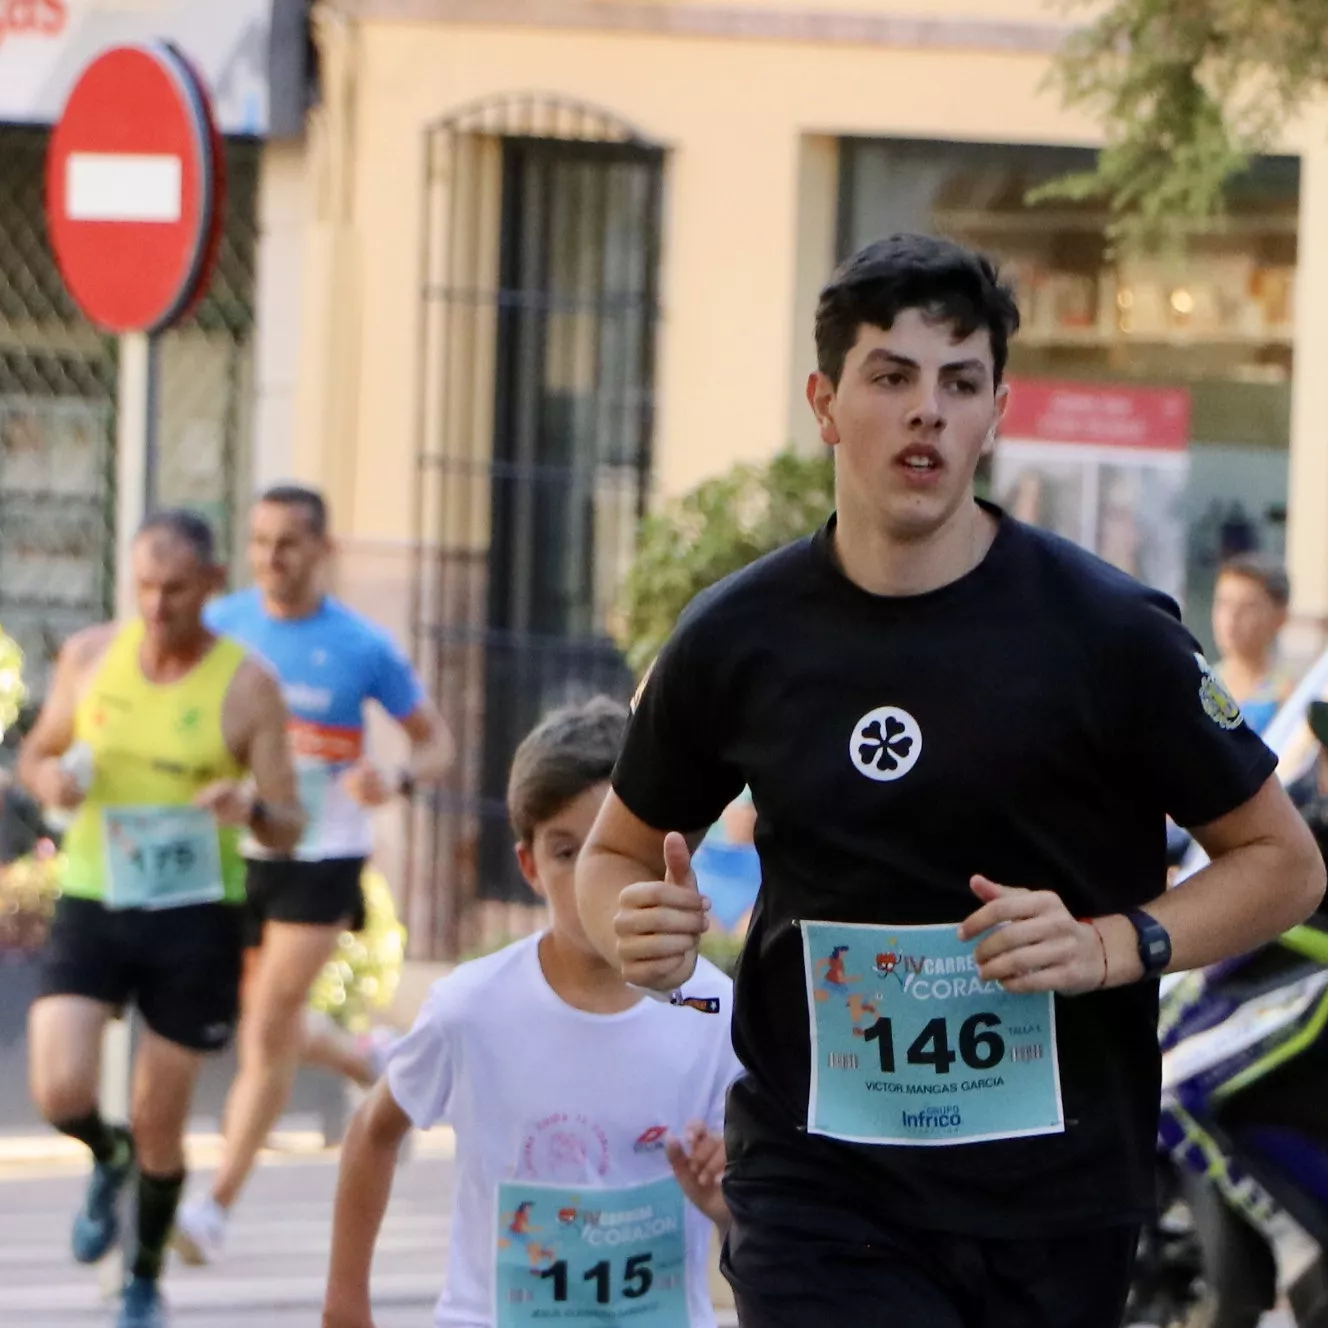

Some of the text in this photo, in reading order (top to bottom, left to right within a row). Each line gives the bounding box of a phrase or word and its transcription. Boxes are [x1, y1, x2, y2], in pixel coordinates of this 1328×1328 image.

[924, 954, 978, 975] CARRE
[864, 1012, 1006, 1075] 146
[906, 1083, 958, 1095] MANGAS
[901, 1110, 962, 1128] Infrico
[926, 1105, 960, 1115] GRUPO
[540, 1252, 654, 1304] 115
